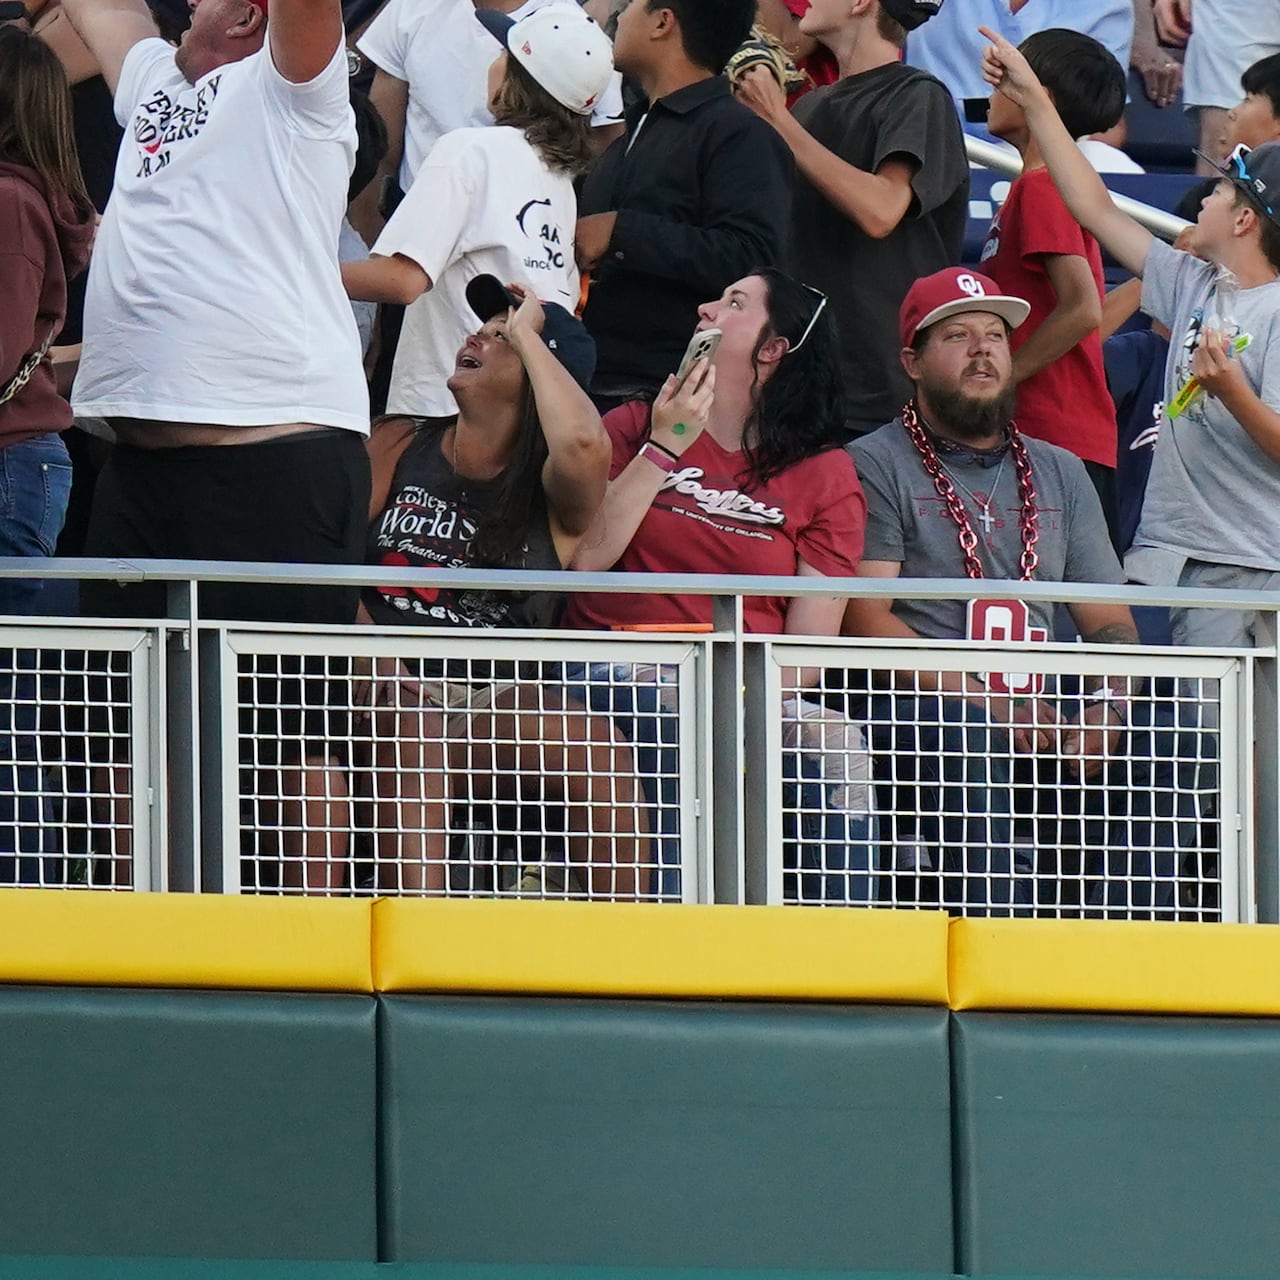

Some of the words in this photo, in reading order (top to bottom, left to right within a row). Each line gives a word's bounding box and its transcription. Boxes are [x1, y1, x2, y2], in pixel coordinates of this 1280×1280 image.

[956, 273, 985, 298] OU
[379, 506, 458, 539] World
[397, 538, 448, 562] Greatest
